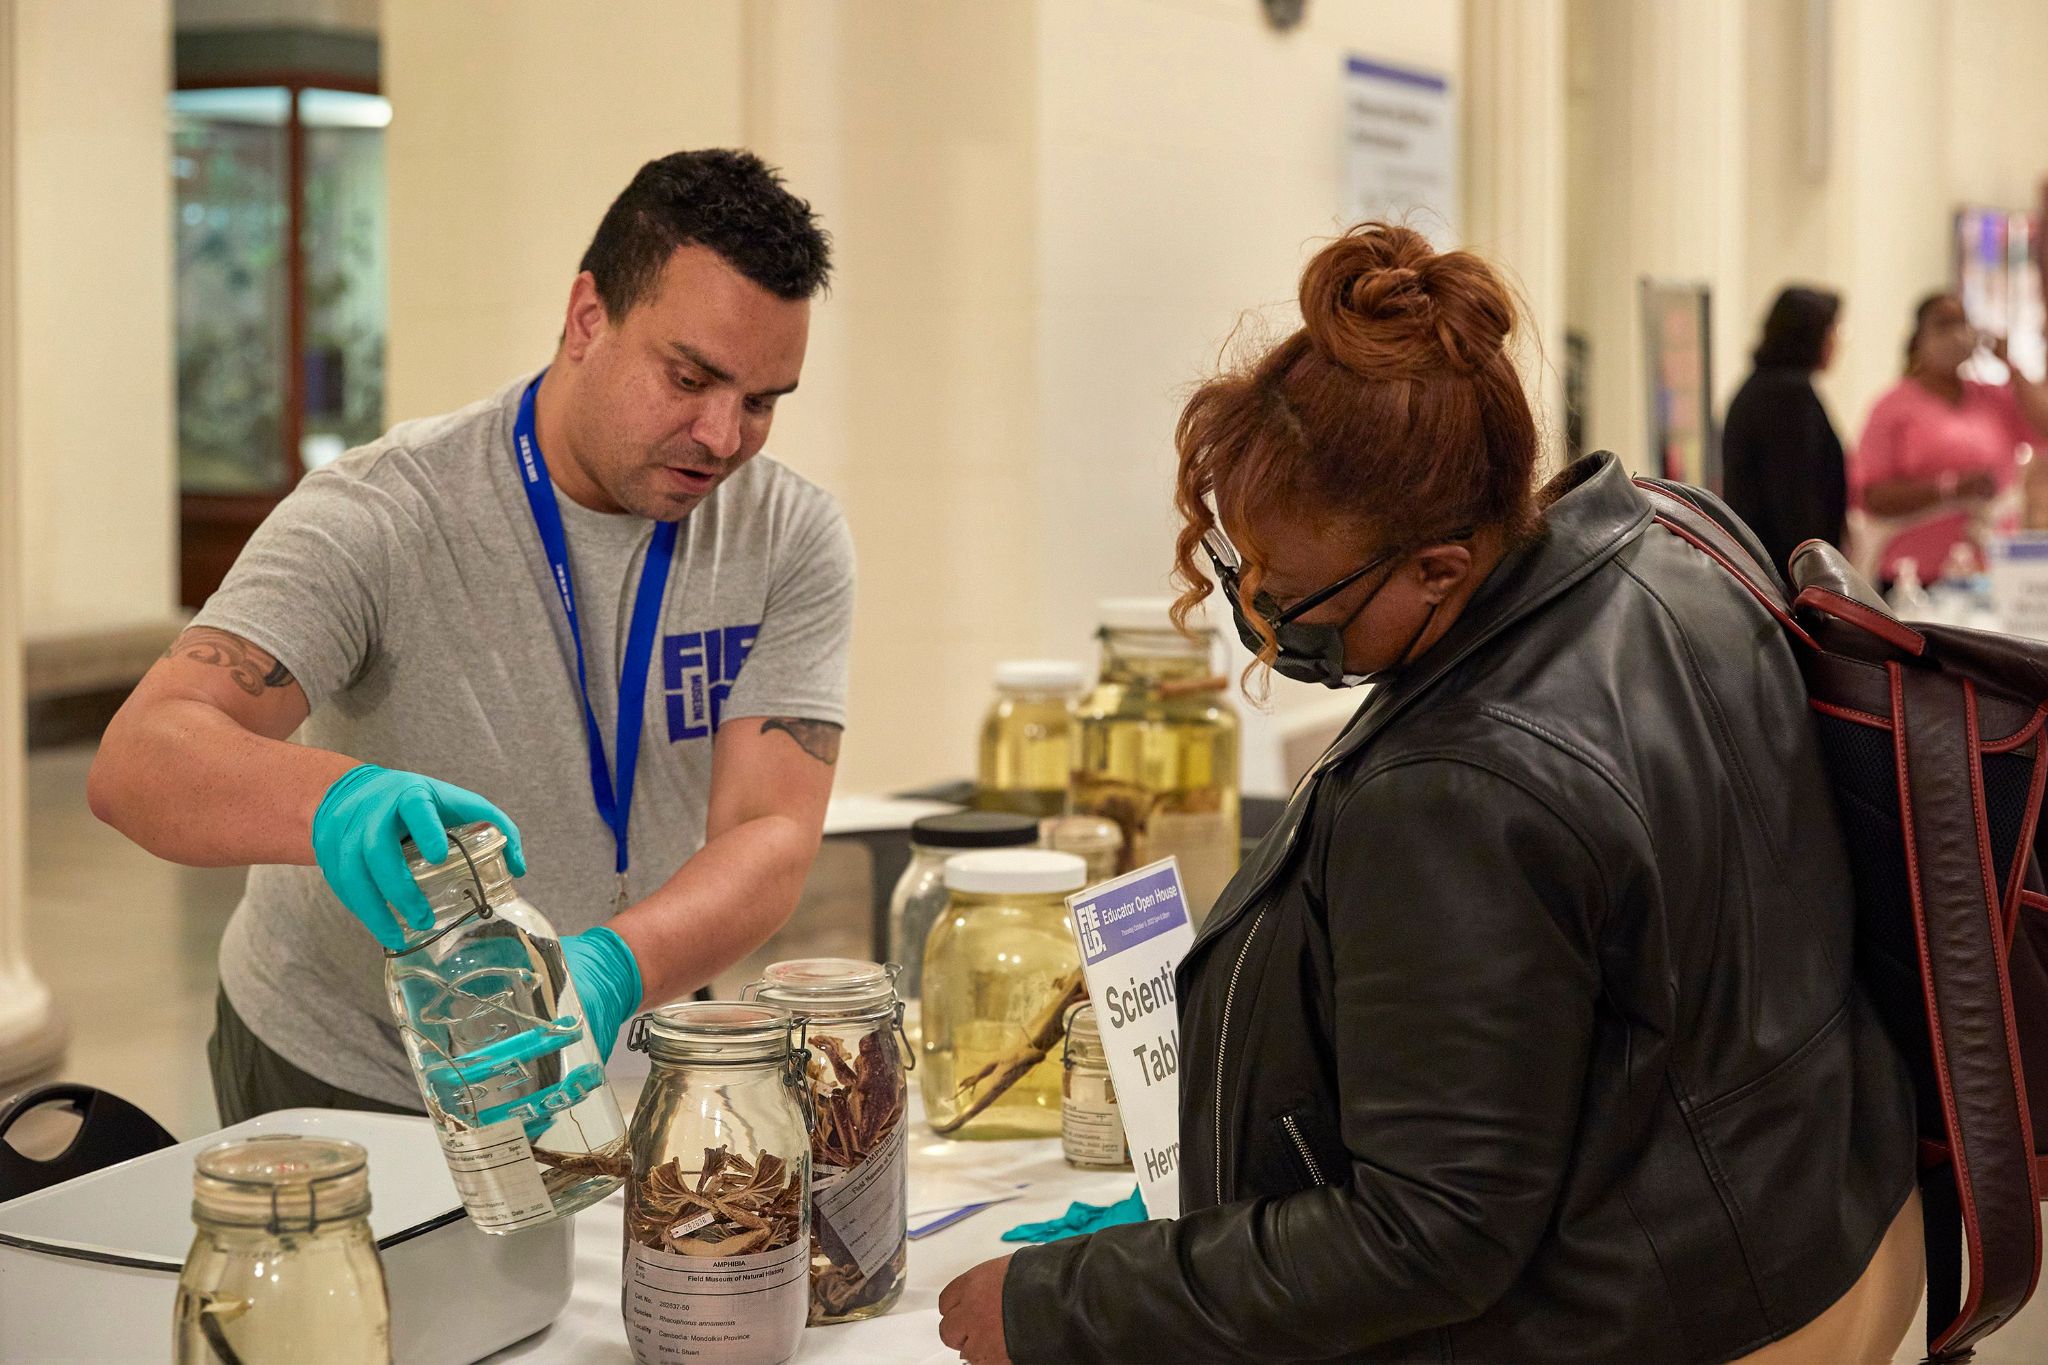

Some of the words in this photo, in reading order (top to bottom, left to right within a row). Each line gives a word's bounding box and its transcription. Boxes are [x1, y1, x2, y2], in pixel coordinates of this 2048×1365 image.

[1101, 901, 1135, 926] Educator
[1135, 896, 1155, 914] Open
[1155, 885, 1178, 904] House
[865, 1132, 896, 1167] AMPHIBIA
[852, 1180, 866, 1195] Field
[713, 1260, 746, 1268] AMPHIBIA
[705, 1275, 732, 1283] Museum
[742, 1271, 765, 1280] Natural
[765, 1267, 785, 1278] History
[633, 1322, 652, 1334] Locality
[723, 1333, 751, 1342] Province
[681, 1347, 700, 1356] Stuart
